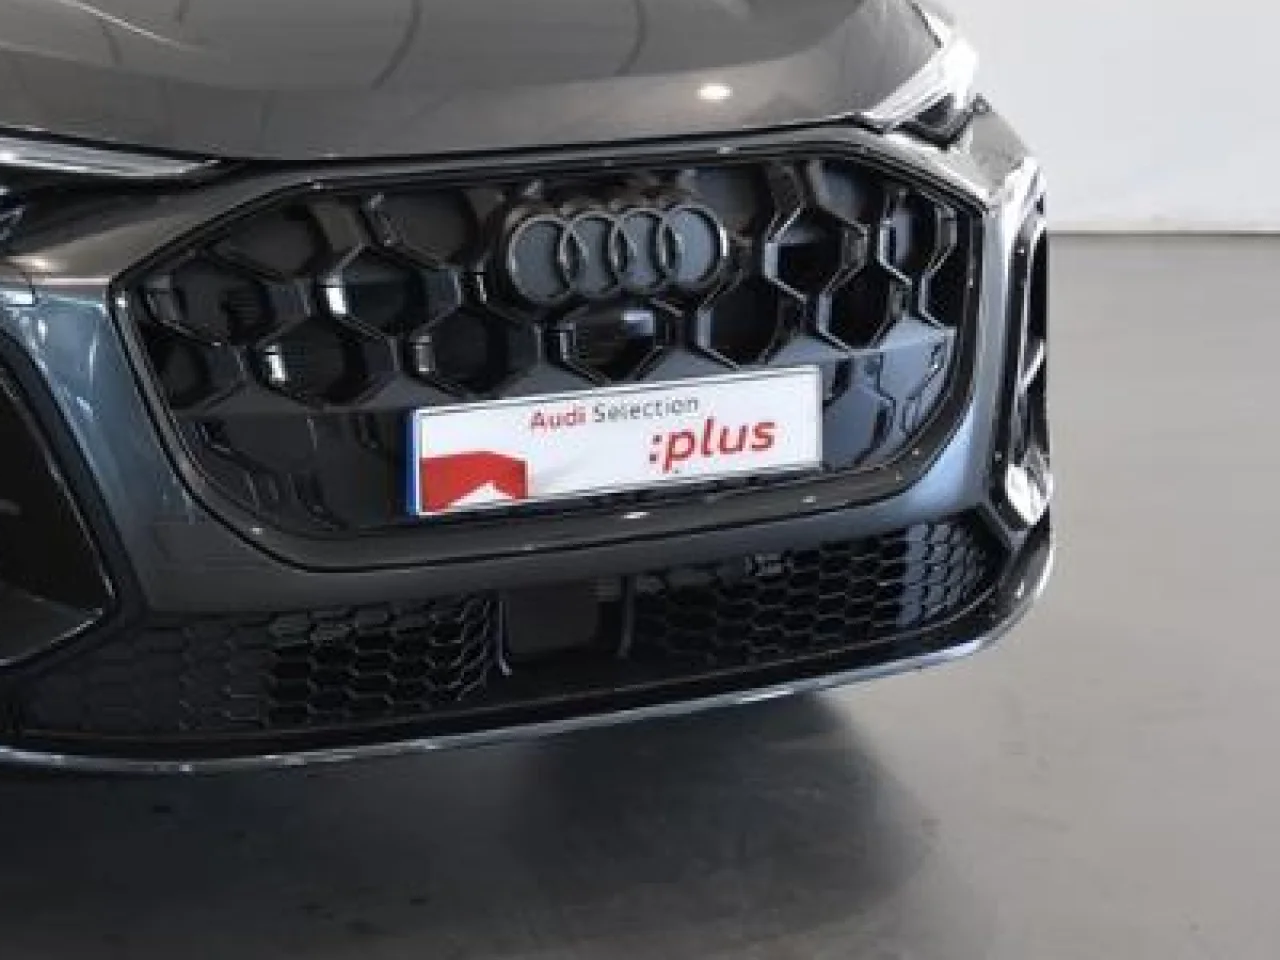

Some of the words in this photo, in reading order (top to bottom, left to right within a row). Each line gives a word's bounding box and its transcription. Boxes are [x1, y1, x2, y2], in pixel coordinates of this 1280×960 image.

[530, 404, 587, 431] Audi
[592, 396, 700, 423] Selection
[649, 417, 776, 472] :plus
